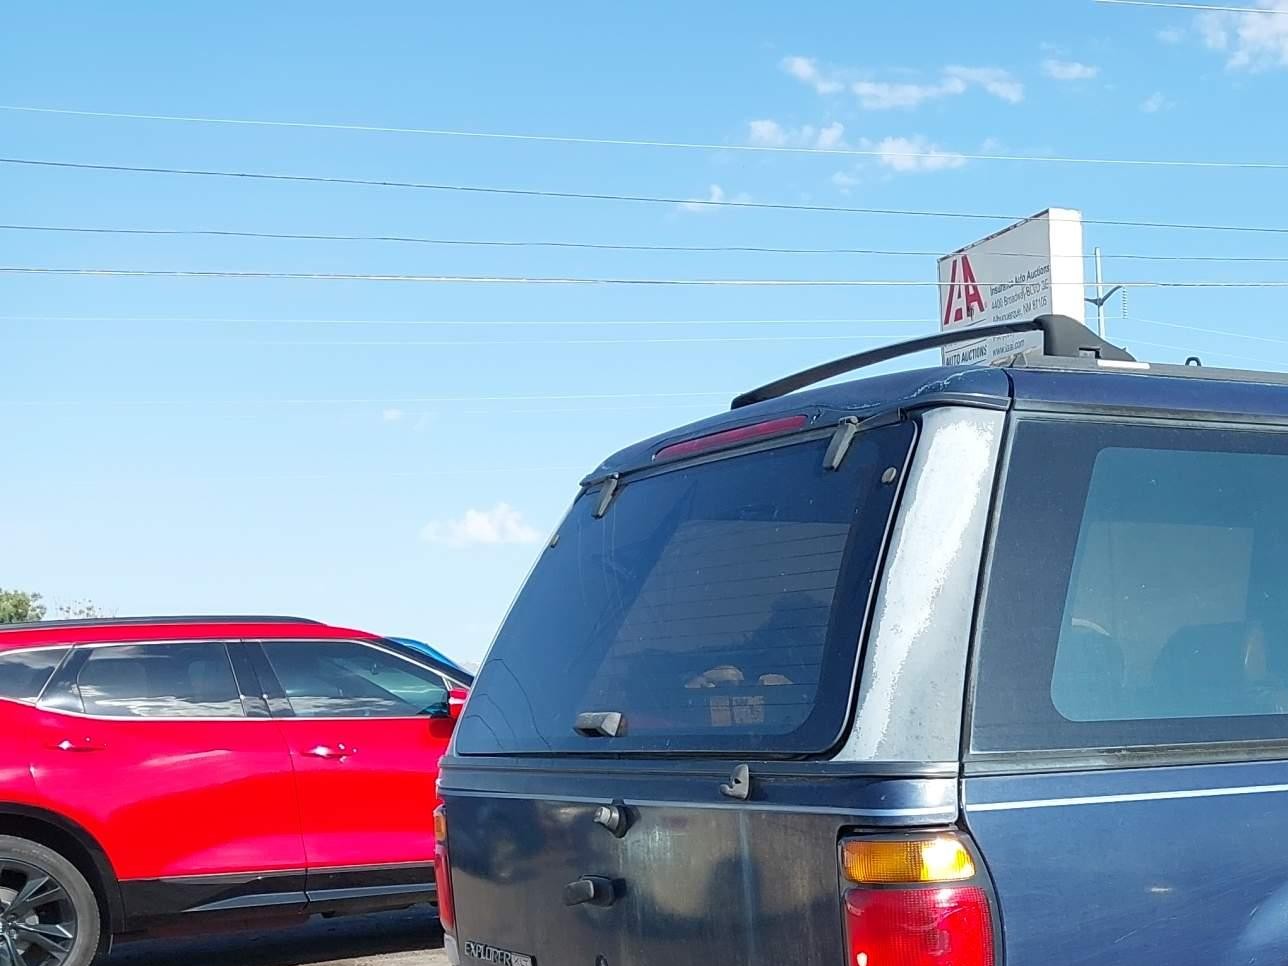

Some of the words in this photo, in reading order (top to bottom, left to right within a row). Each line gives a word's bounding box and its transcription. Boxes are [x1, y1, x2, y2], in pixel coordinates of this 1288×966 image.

[1026, 264, 1050, 281] Auctions
[961, 344, 988, 362] AUCTIONS
[464, 941, 511, 966] EXPLORER
